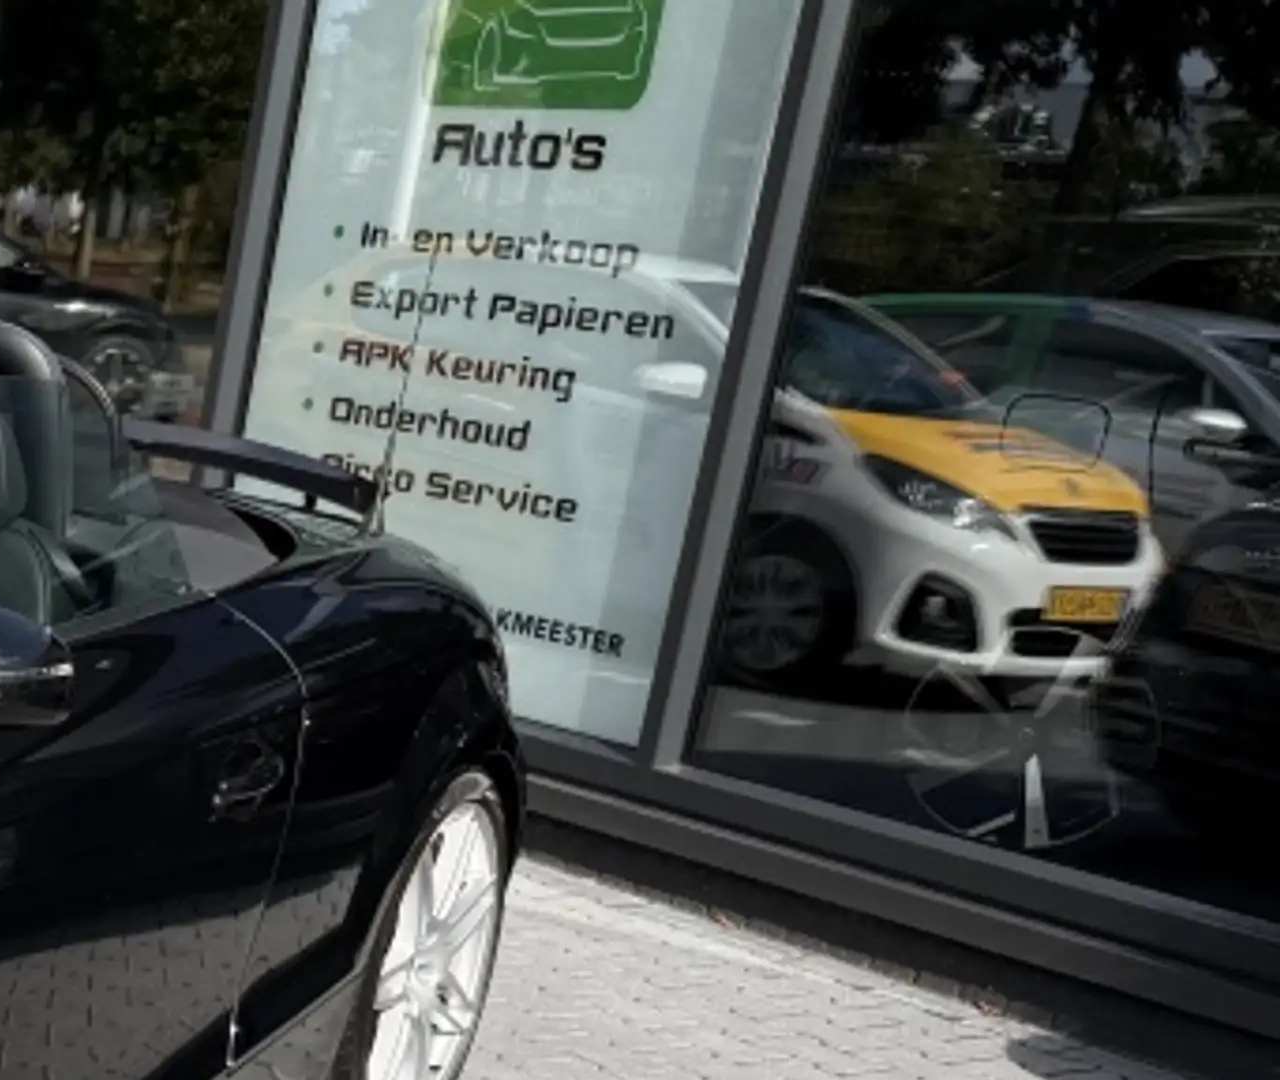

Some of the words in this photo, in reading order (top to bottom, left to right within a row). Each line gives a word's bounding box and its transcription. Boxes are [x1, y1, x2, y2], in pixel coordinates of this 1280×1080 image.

[432, 120, 607, 172] Auto's
[411, 228, 453, 256] en
[465, 229, 640, 278] Verkoop
[350, 280, 478, 320] Export
[488, 293, 675, 341] Papieren
[338, 337, 414, 372] APK
[425, 350, 577, 403] Keuring
[330, 397, 532, 452] Onderhoud
[425, 471, 579, 523] Service
[489, 604, 627, 658] KMEESTER
